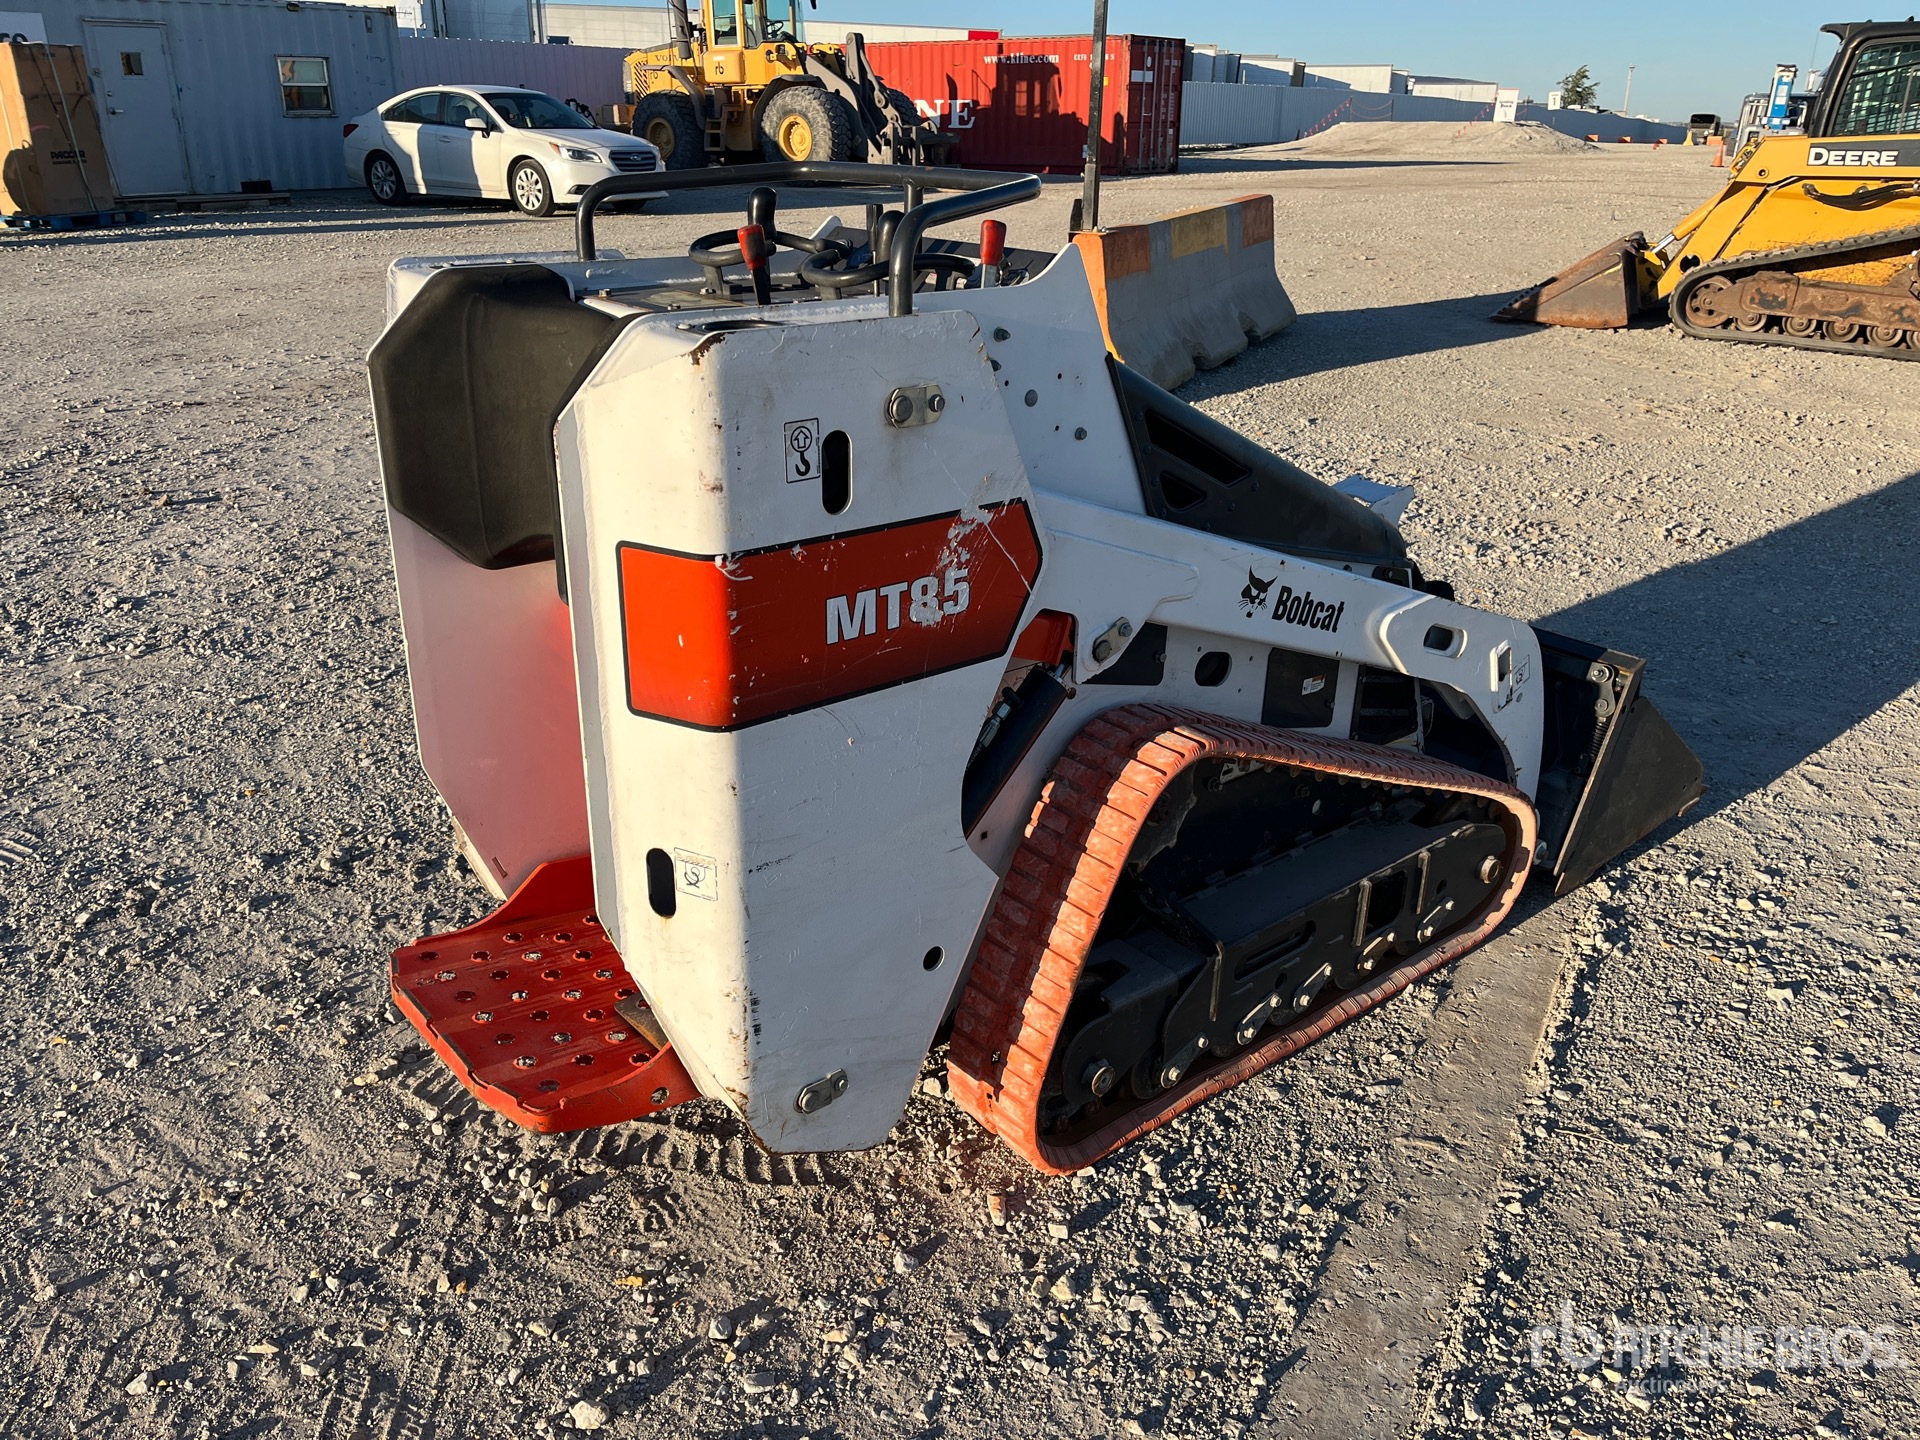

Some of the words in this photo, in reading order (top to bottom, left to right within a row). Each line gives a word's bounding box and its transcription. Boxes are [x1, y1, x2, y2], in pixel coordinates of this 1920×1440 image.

[983, 52, 1060, 64] www.kline.com
[1807, 147, 1899, 166] DEERE
[826, 567, 971, 645] MT85
[1271, 585, 1345, 633] Bobcat
